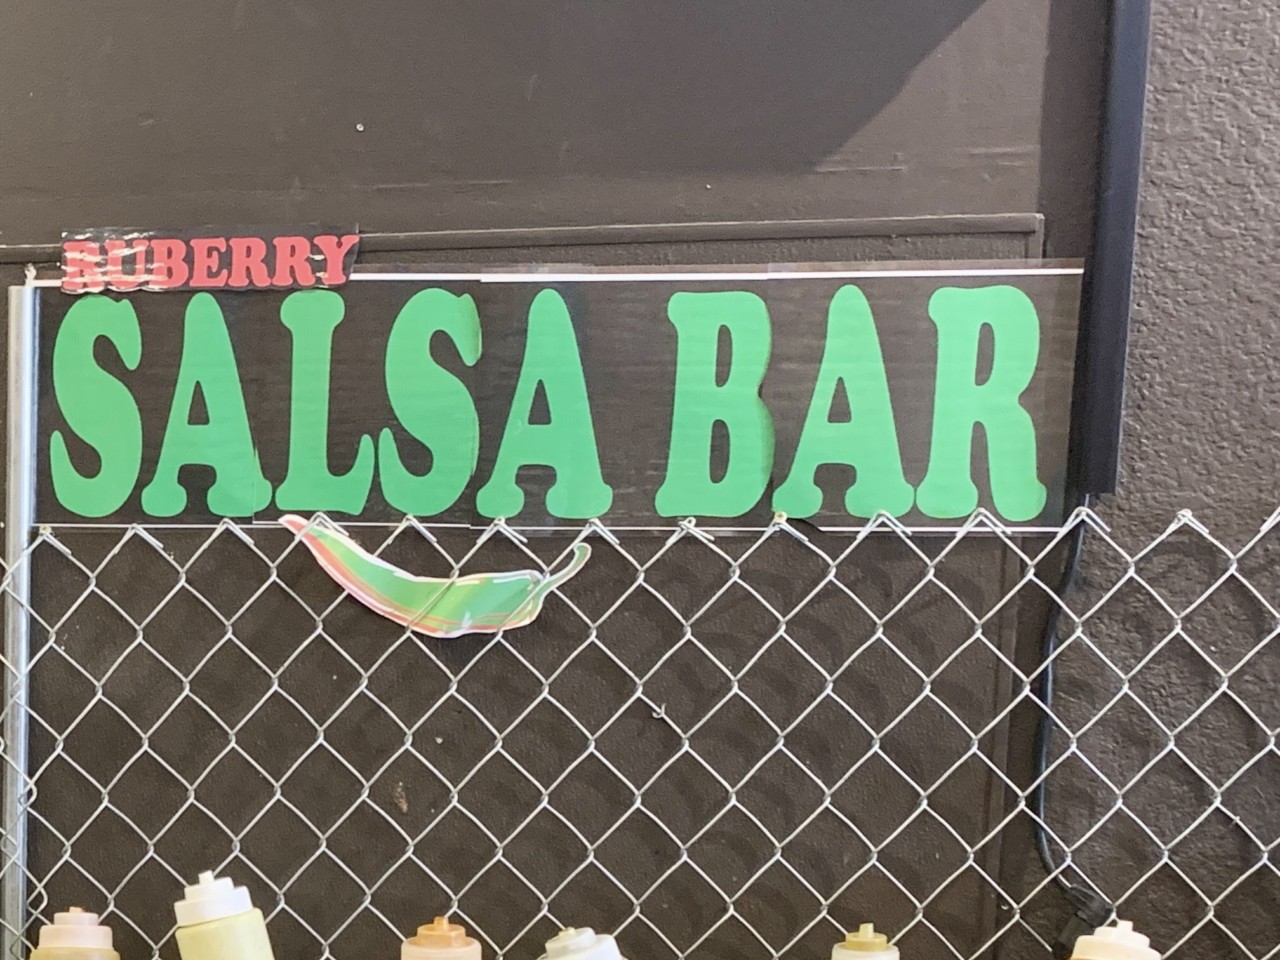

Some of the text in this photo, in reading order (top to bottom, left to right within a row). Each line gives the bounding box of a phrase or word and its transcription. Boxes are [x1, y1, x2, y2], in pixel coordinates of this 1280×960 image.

[61, 234, 360, 290] RUBERRY
[49, 284, 1047, 521] SALSA BAR
